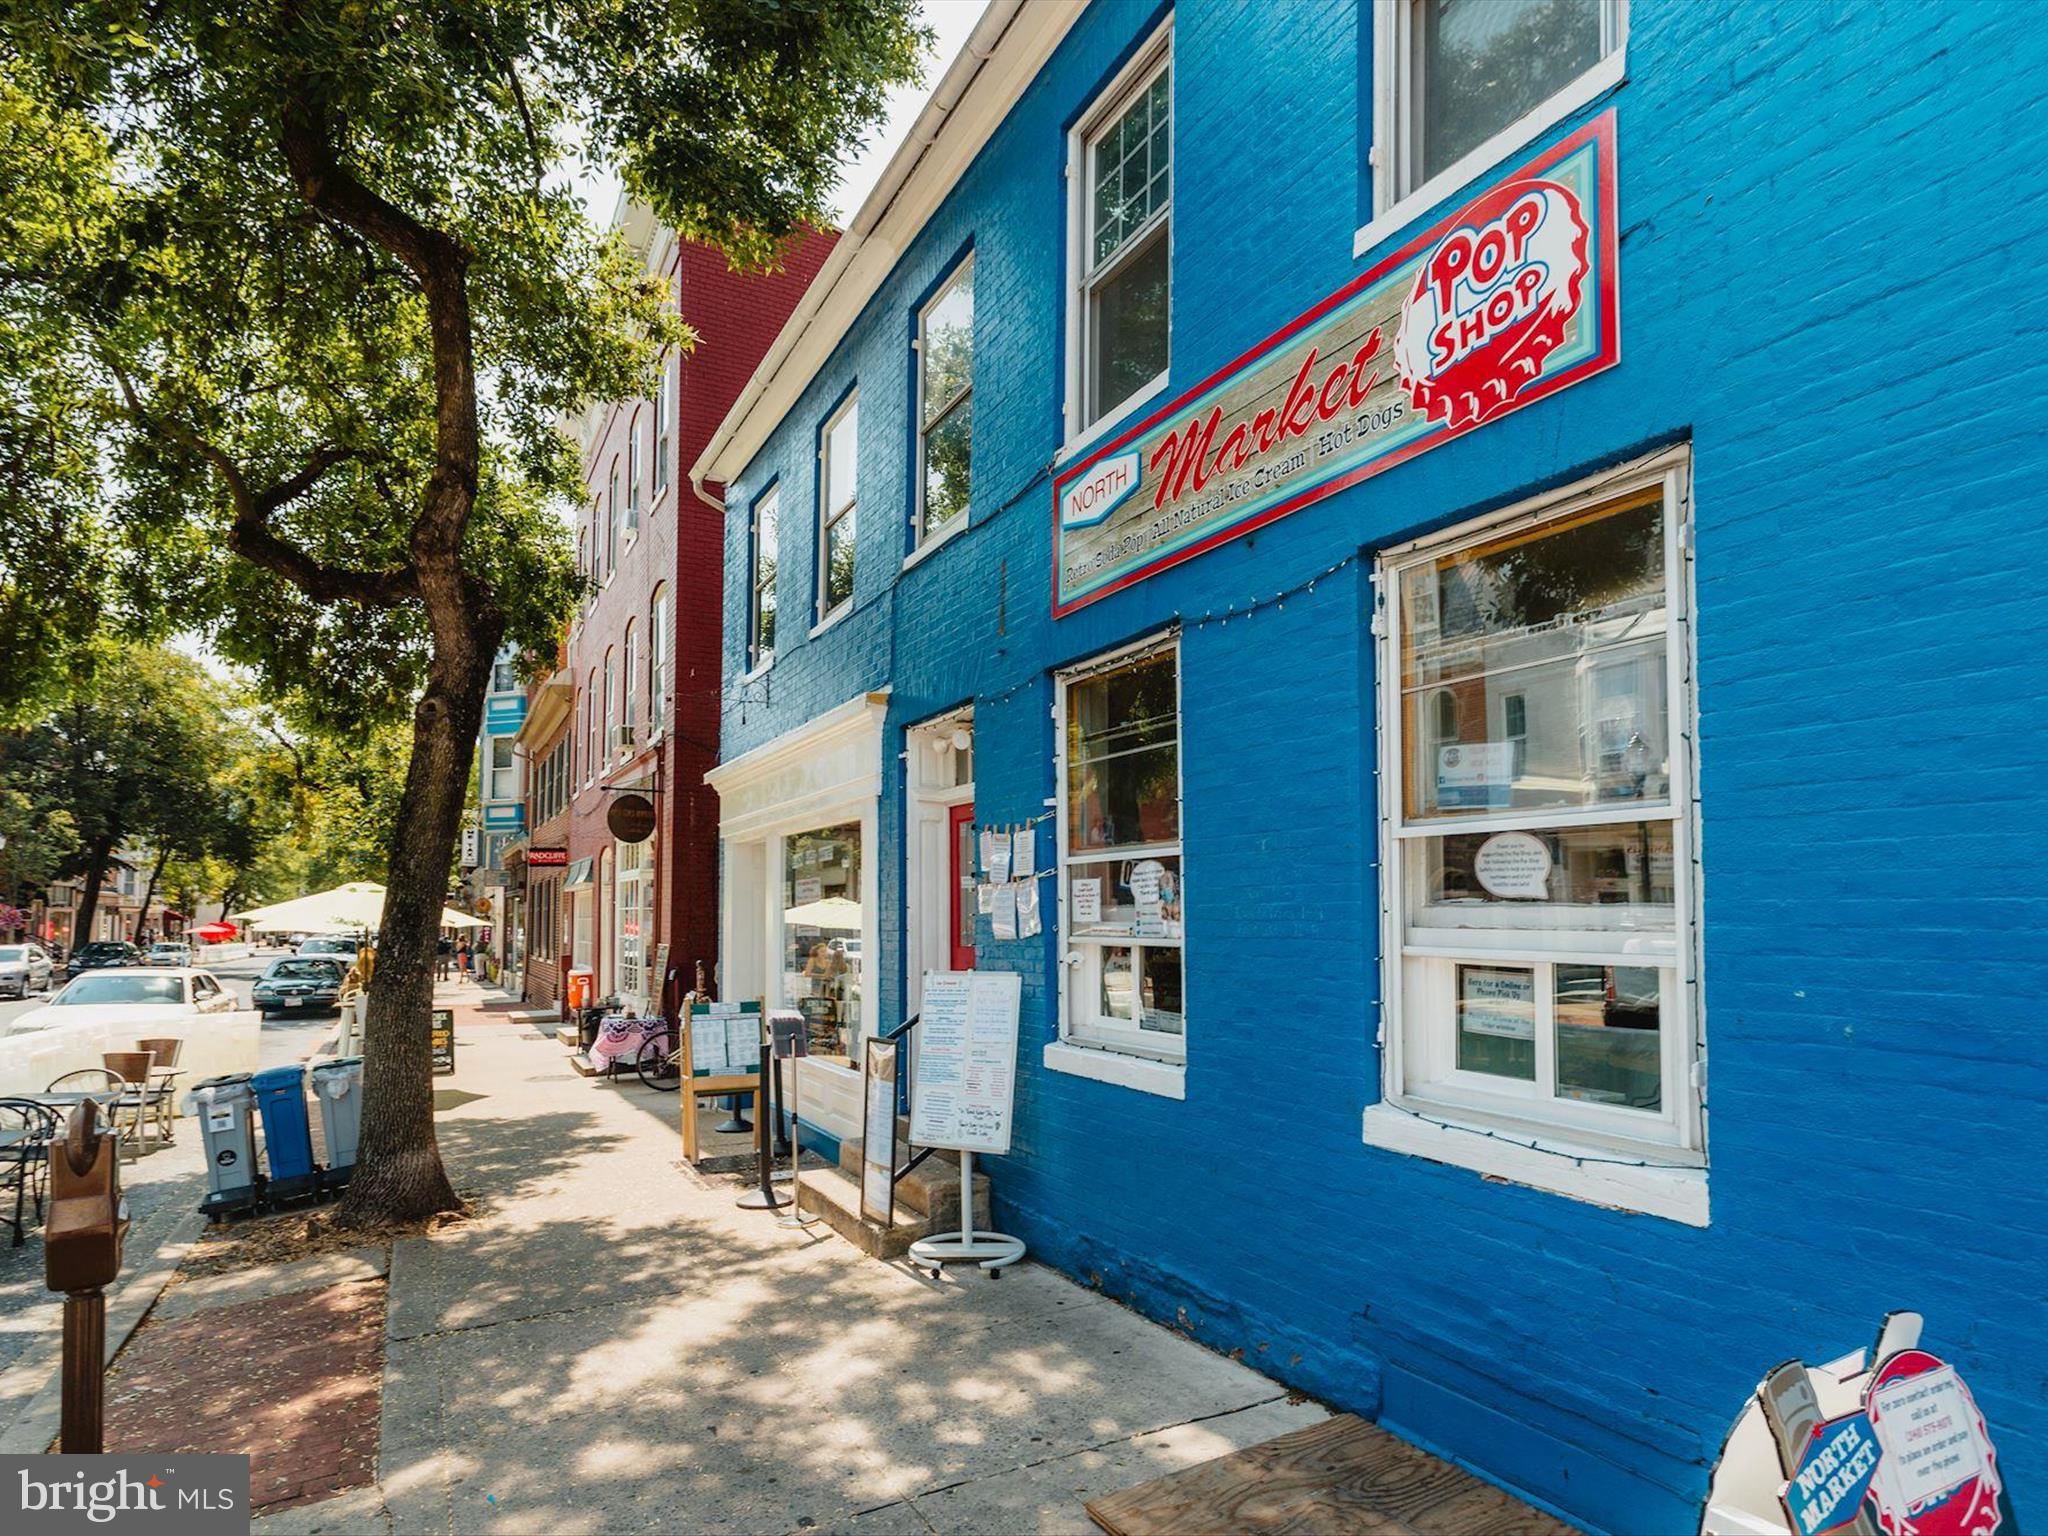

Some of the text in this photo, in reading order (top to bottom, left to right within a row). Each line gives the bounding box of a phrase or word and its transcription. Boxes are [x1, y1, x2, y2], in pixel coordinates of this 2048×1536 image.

[1431, 200, 1539, 316] POP
[1434, 269, 1541, 369] SHOP
[1150, 326, 1383, 511] Market
[1072, 464, 1127, 517] NORTH
[1123, 534, 1144, 554] Pop
[1152, 522, 1170, 541] All
[1174, 489, 1225, 529] Natural
[1229, 480, 1250, 501] Ice
[1254, 452, 1305, 489] Cream
[1319, 424, 1352, 456] Hot
[1358, 401, 1403, 438] Dogs
[1796, 1422, 1861, 1500] NORTH
[1800, 1439, 1876, 1534] MARKET
